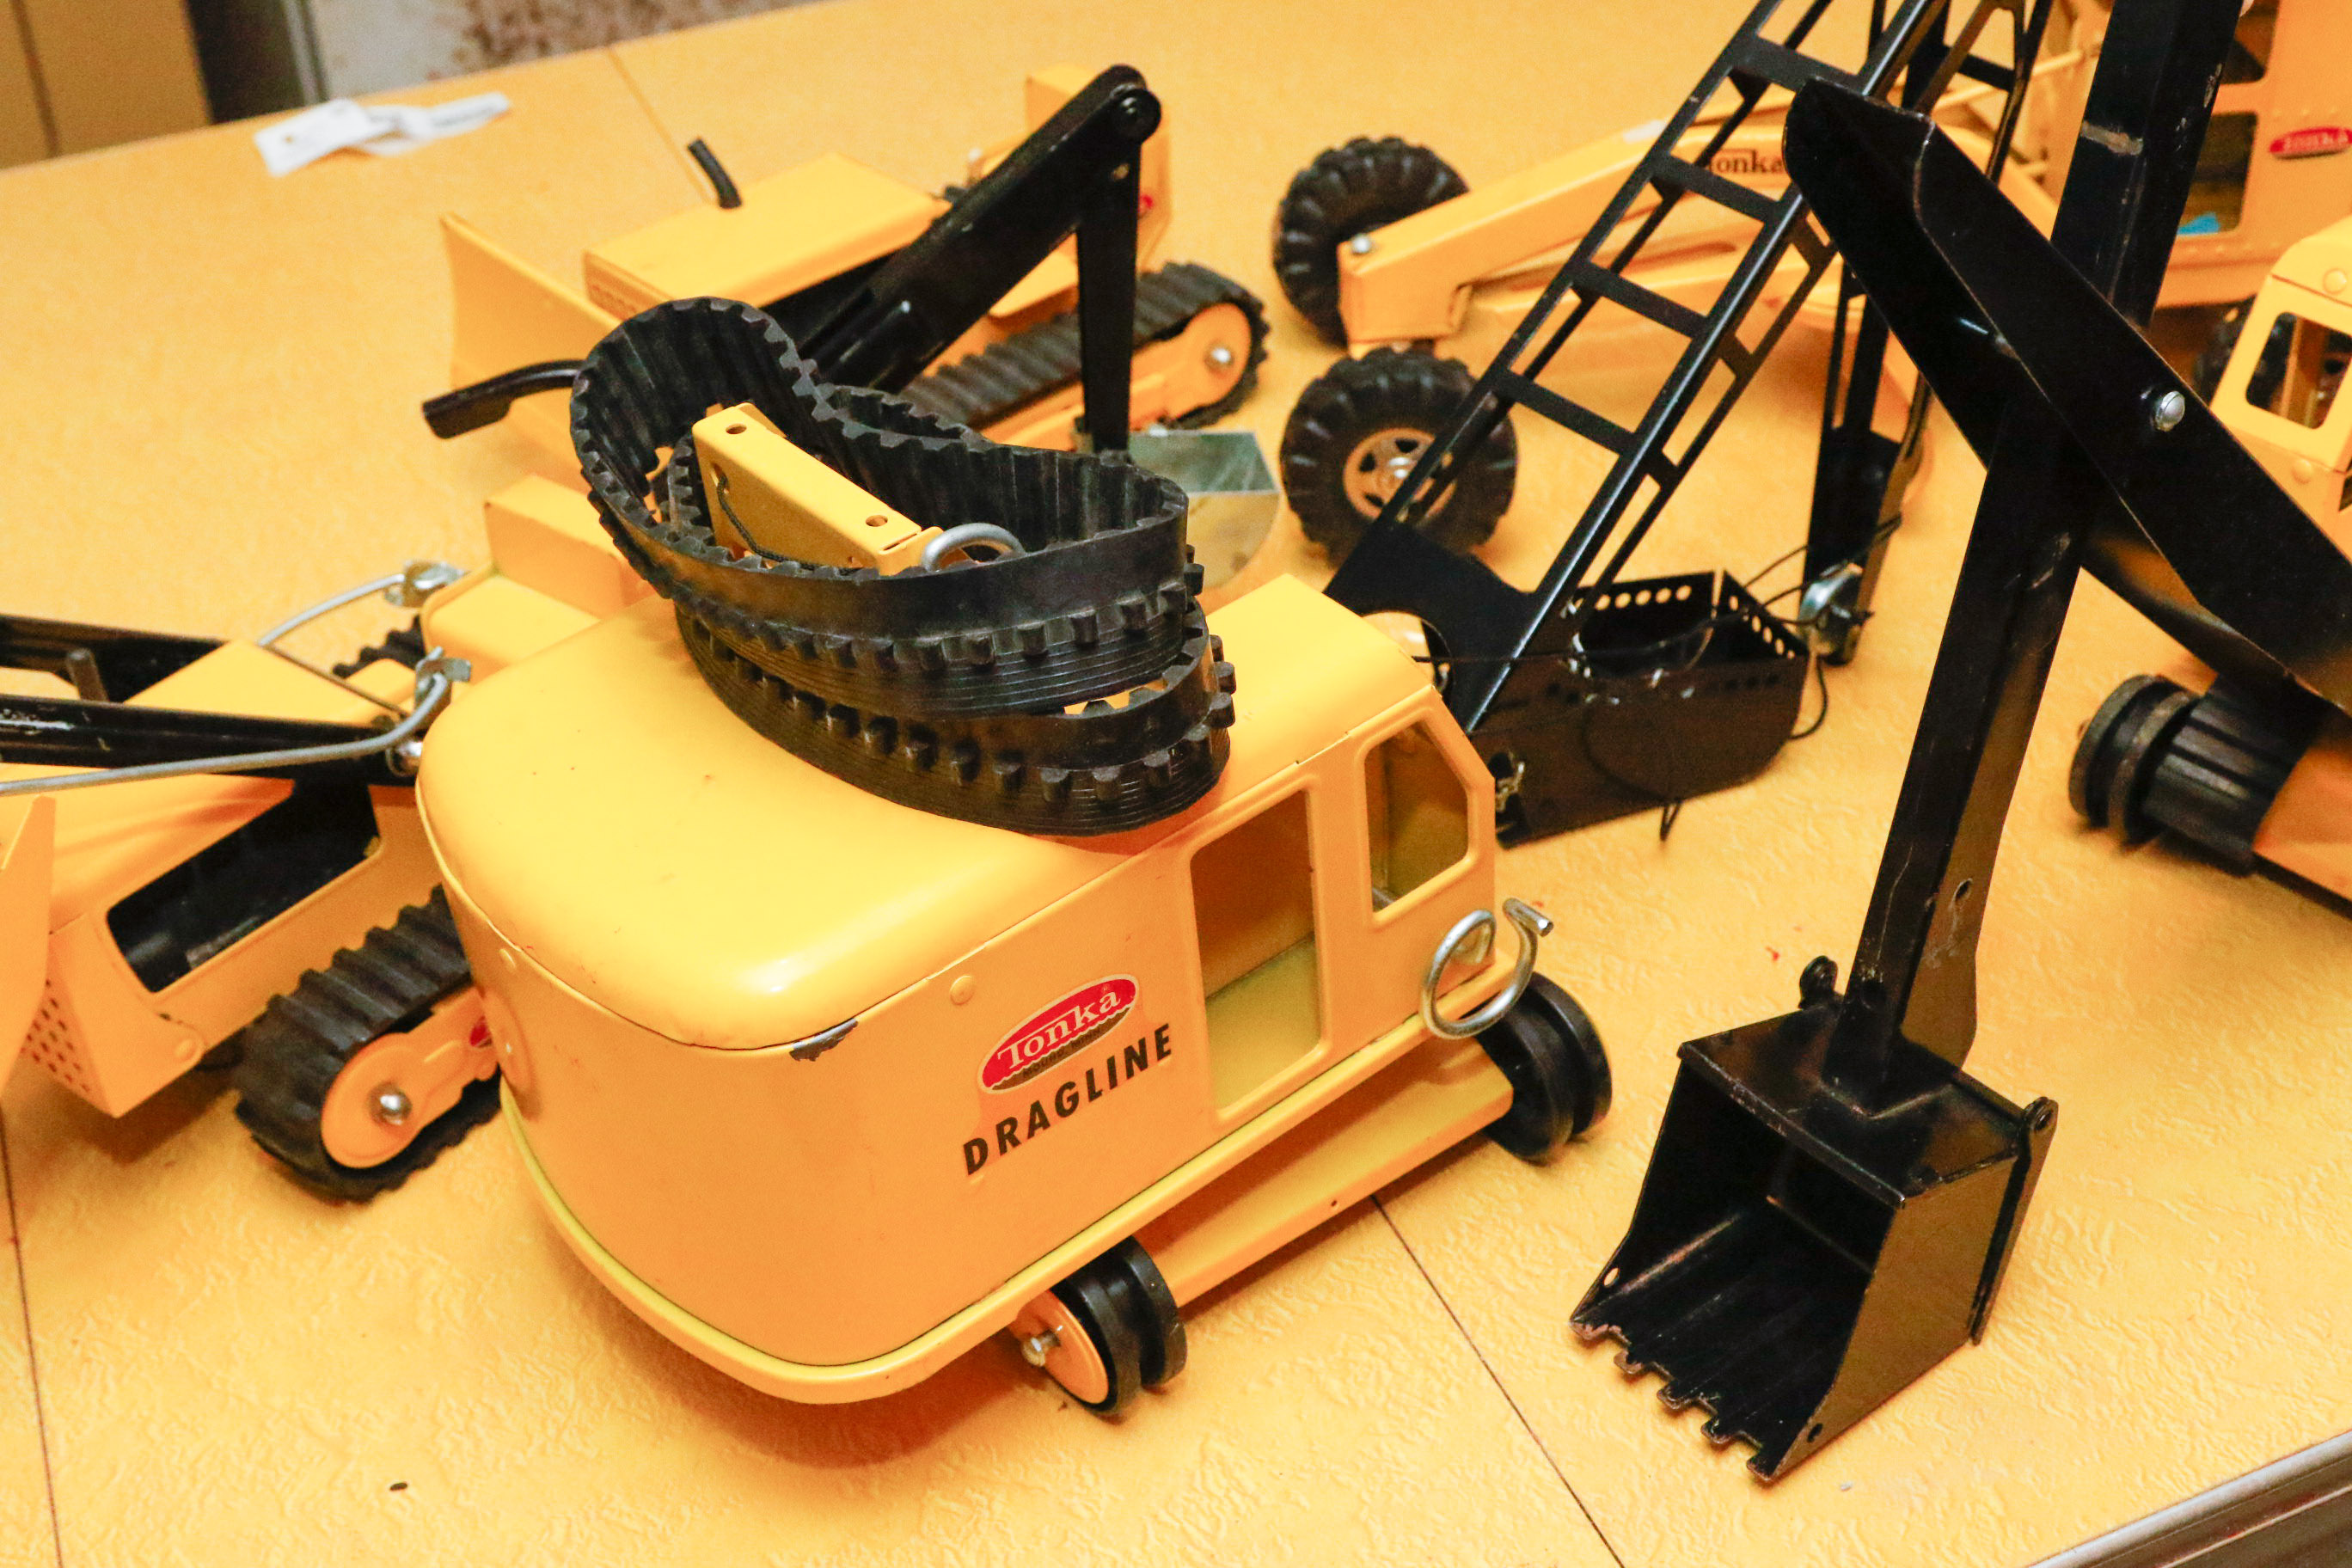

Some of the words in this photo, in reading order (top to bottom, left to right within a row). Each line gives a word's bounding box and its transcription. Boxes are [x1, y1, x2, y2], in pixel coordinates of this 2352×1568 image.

[1711, 148, 1785, 174] onka
[997, 990, 1122, 1069] Tonka
[963, 1023, 1172, 1176] DRAGLINE
